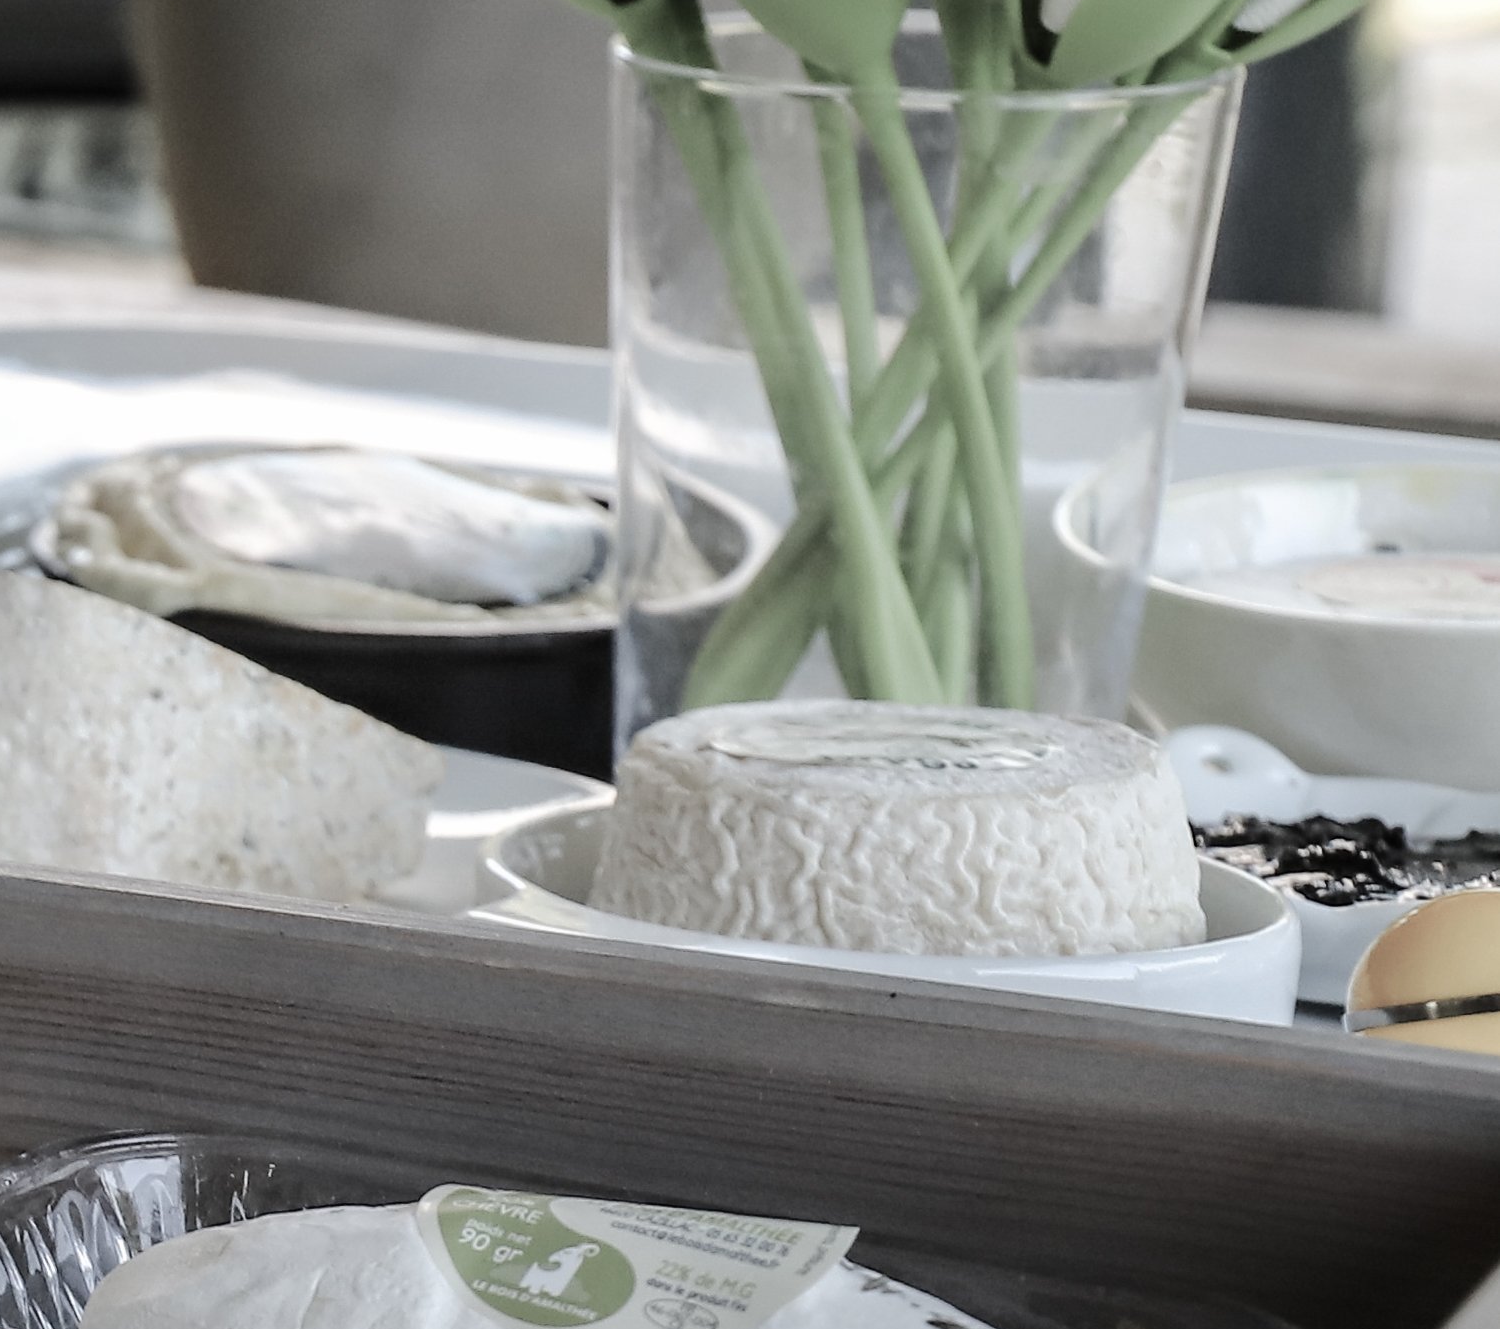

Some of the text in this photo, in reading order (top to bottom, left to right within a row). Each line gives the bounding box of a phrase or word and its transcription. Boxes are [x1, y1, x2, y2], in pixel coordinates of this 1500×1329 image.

[459, 1227, 524, 1263] 90 gr
[472, 1279, 487, 1291] LE
